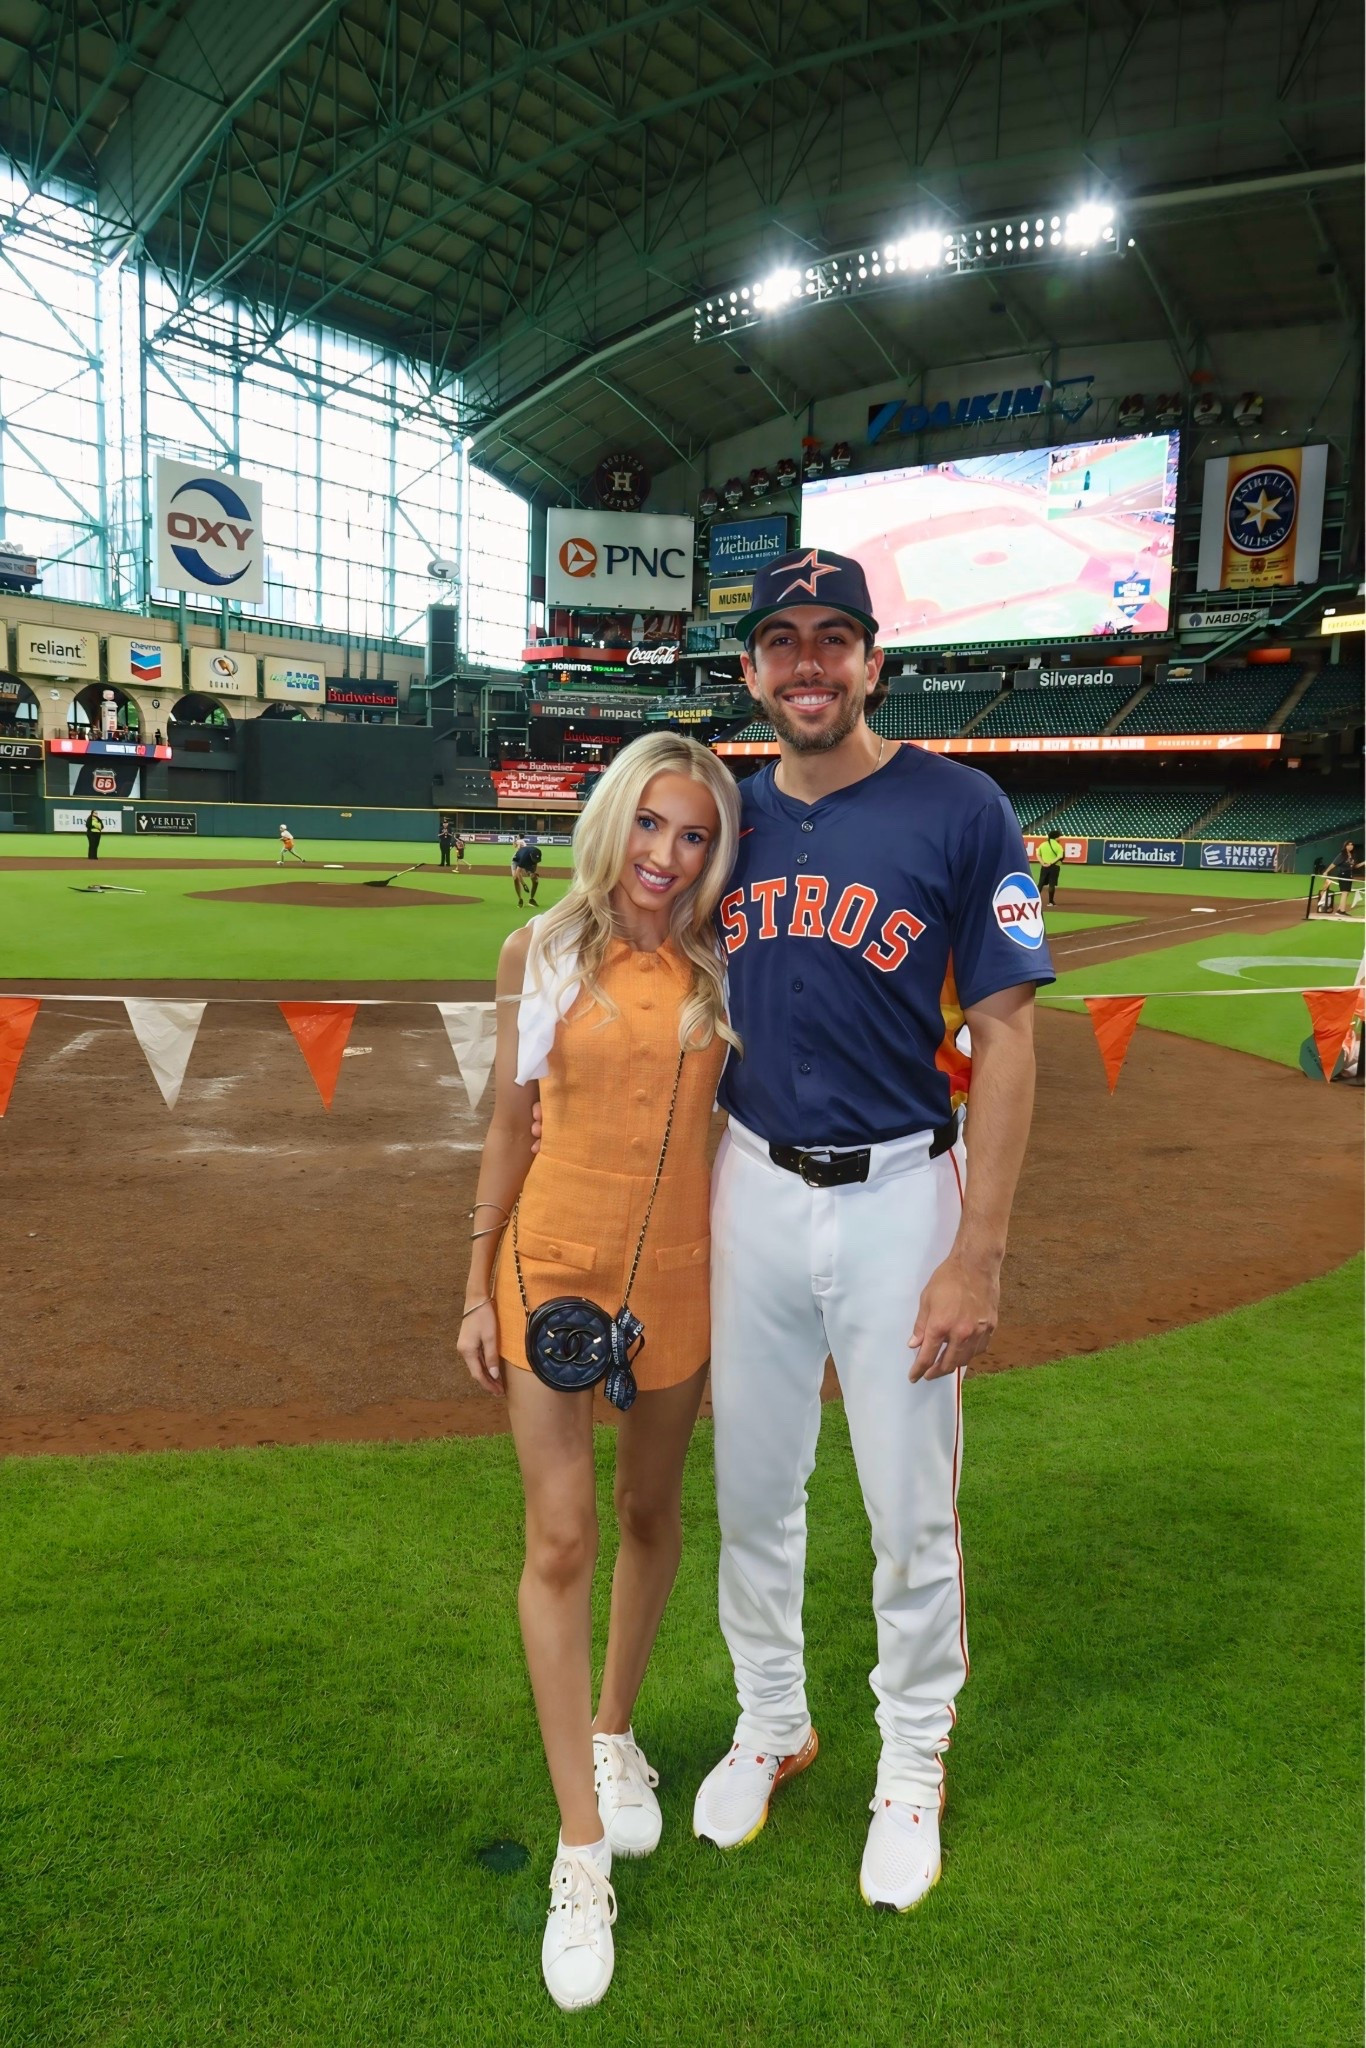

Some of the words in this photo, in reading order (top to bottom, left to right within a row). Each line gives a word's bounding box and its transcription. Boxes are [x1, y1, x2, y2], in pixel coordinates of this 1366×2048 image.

[900, 384, 1044, 433] DAIKIN
[602, 455, 644, 472] HOUSTON
[613, 471, 632, 491] H
[1235, 475, 1293, 502] ESTRELLA
[603, 493, 641, 508] ASTROS
[167, 512, 255, 551] OXY
[715, 534, 741, 542] HOUSTON
[1237, 527, 1285, 547] JALISCO
[716, 534, 780, 556] Methodist
[603, 544, 686, 579] PNC
[718, 592, 752, 605] MUSTAN
[1205, 612, 1257, 625] NABORS
[30, 640, 82, 659] reliant
[130, 641, 162, 652] Chevron
[626, 645, 680, 666] Coca-Cola
[552, 663, 593, 672] HORNITOS
[209, 680, 239, 690] QUANTA
[286, 671, 320, 691] LNG
[922, 678, 966, 693] Chevy
[1039, 671, 1114, 687] Silverado
[328, 689, 397, 705] Budweiser
[541, 705, 586, 716] impact
[600, 708, 642, 719] impact
[668, 709, 713, 718] PLUCKERS
[564, 730, 622, 744] Budweiser
[1072, 739, 1099, 751] THE
[529, 761, 575, 772] Budweiser
[97, 778, 112, 789] 66
[518, 772, 566, 782] Budweiser
[510, 780, 560, 791] Budweiser
[72, 815, 117, 827] Insrity
[150, 816, 194, 826] VERITEX
[1109, 845, 1177, 863] Methodist
[1225, 846, 1276, 857] ENERGY
[996, 901, 1040, 924] OXY
[719, 874, 927, 972] STROS
